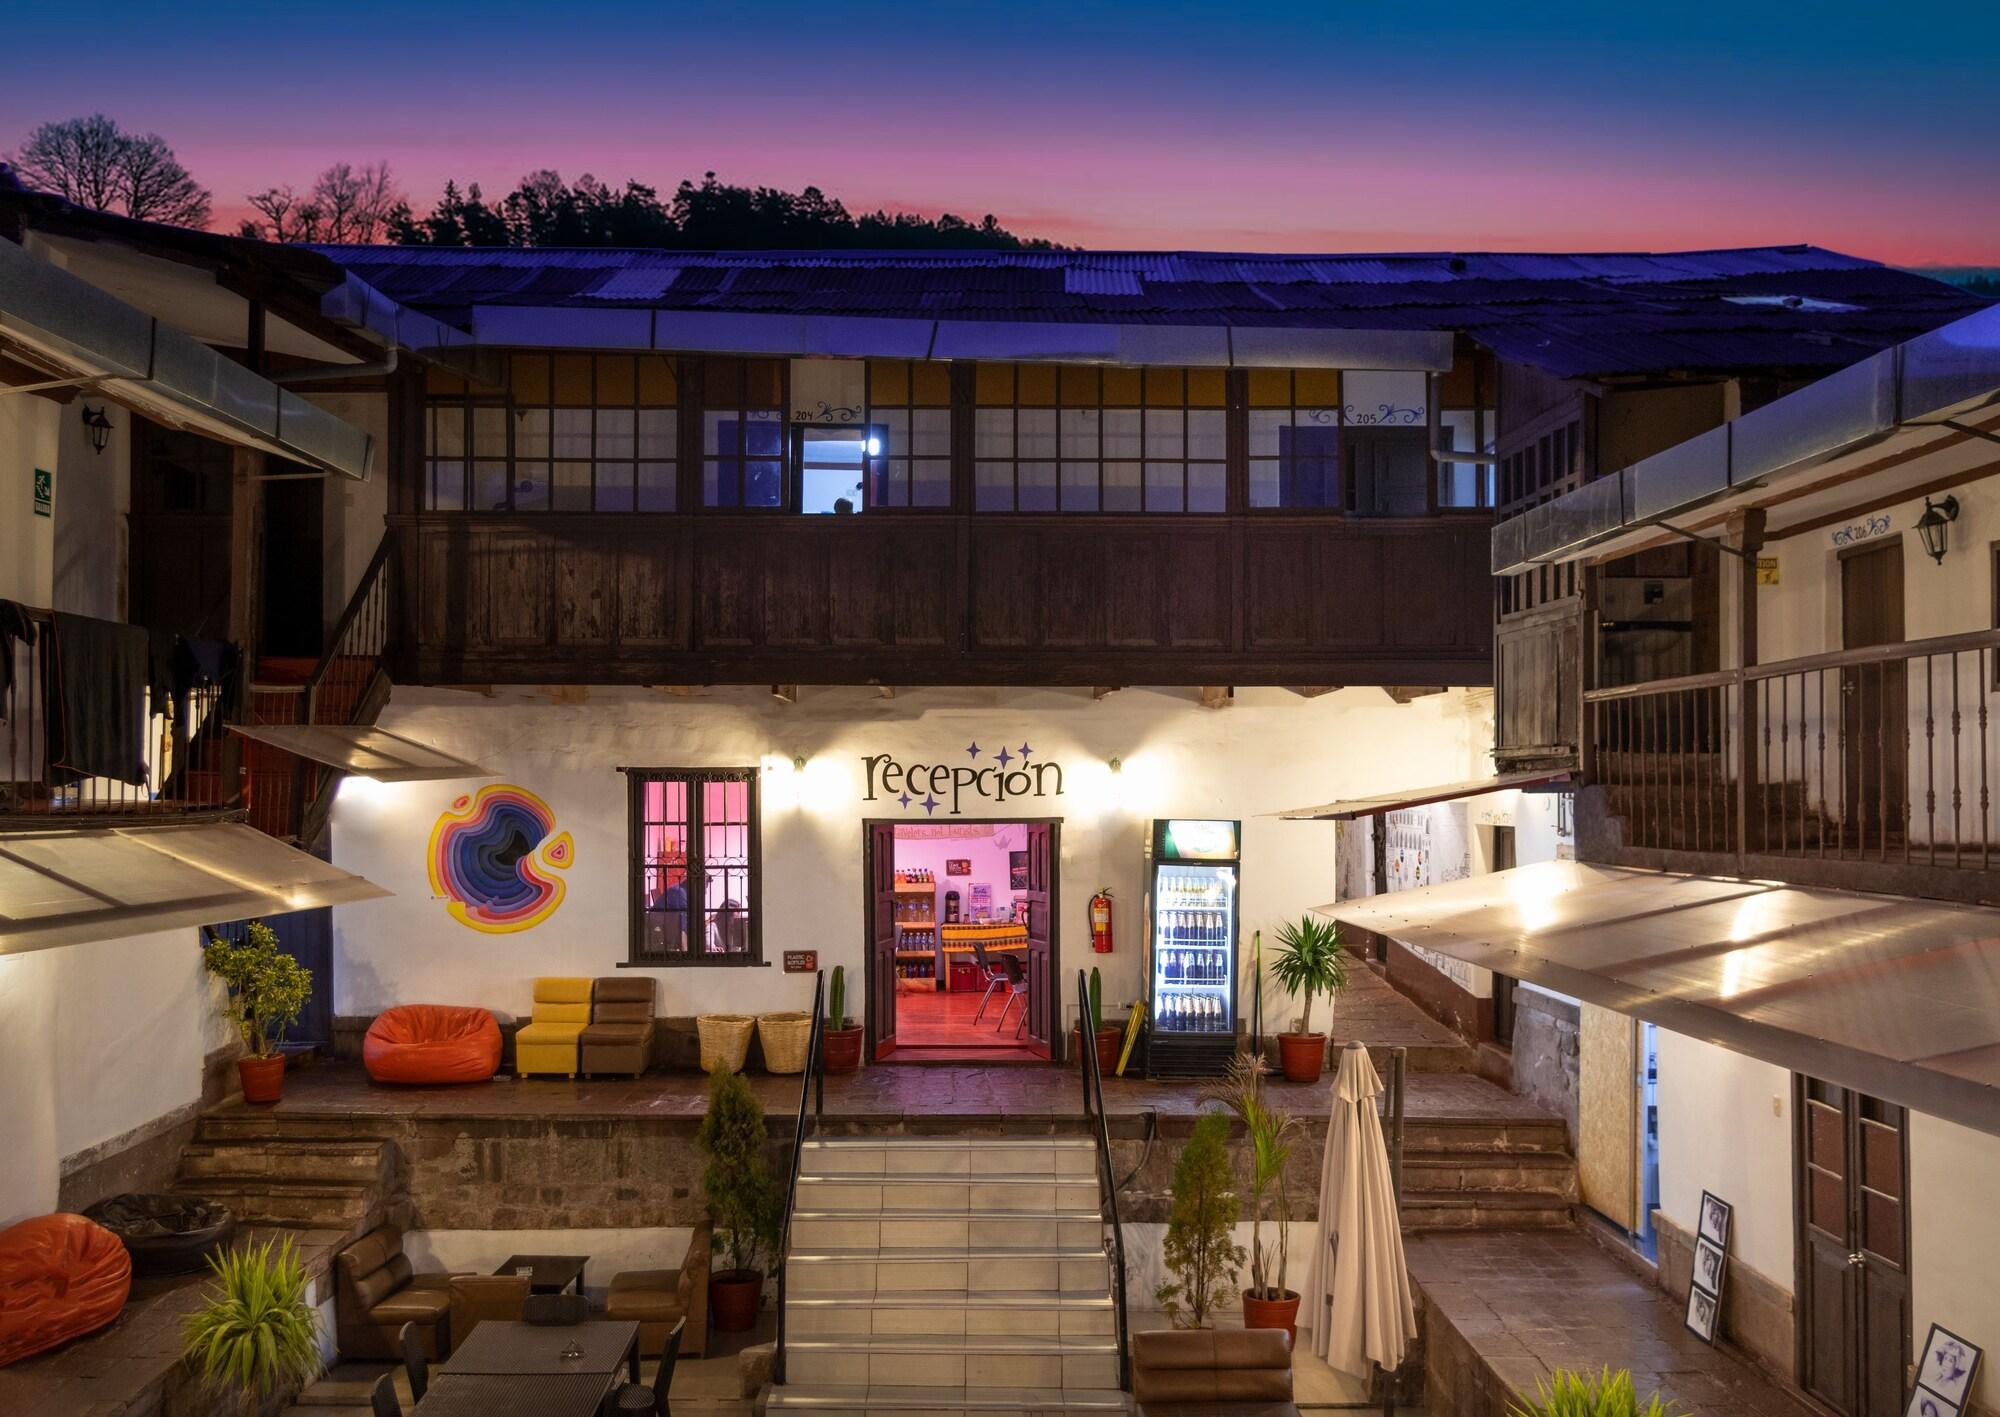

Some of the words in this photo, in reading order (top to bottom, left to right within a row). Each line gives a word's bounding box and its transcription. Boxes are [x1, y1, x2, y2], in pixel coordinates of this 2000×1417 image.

[795, 411, 814, 421] 204
[1356, 413, 1377, 425] 205
[1854, 524, 1867, 540] 206
[861, 753, 1064, 814] recepción
